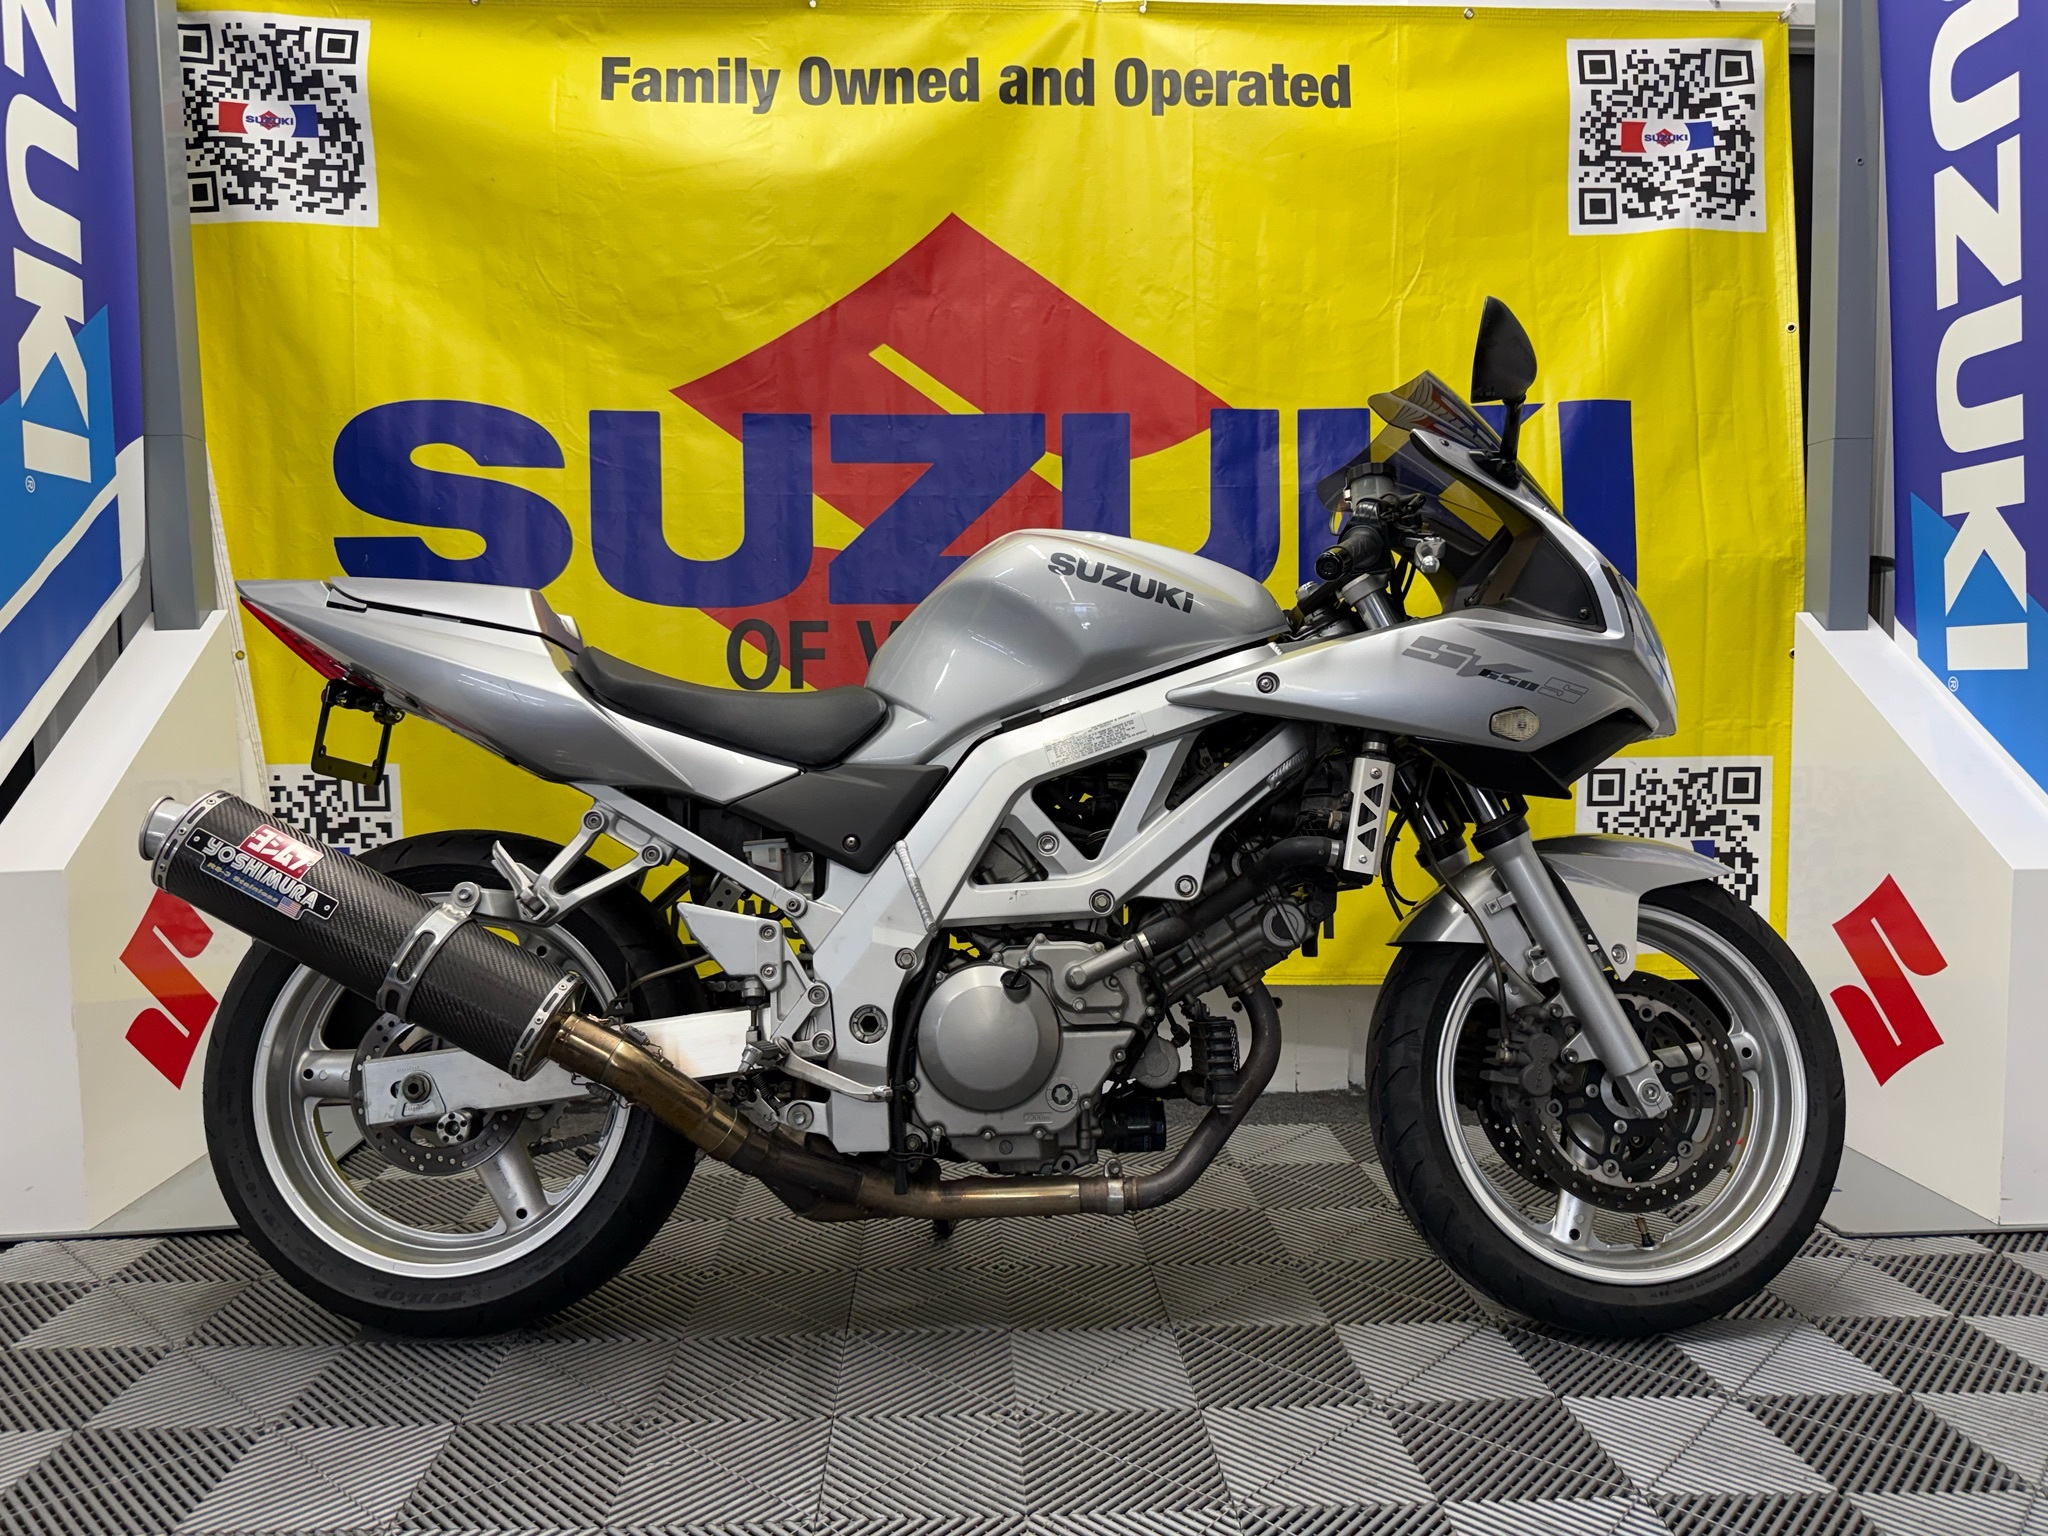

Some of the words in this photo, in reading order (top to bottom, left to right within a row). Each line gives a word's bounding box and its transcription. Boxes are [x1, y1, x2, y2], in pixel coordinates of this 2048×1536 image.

[600, 56, 781, 115] Family
[798, 56, 980, 106] Owned
[998, 57, 1095, 107] and
[1114, 57, 1352, 116] Operated
[245, 115, 294, 126] SUZUKI
[1644, 133, 1689, 142] SUZUKI
[1929, 0, 2029, 671] UZUKI
[1048, 552, 1194, 614] SUZUKI
[726, 618, 829, 691] OF
[202, 836, 319, 910] YOSHIMURA
